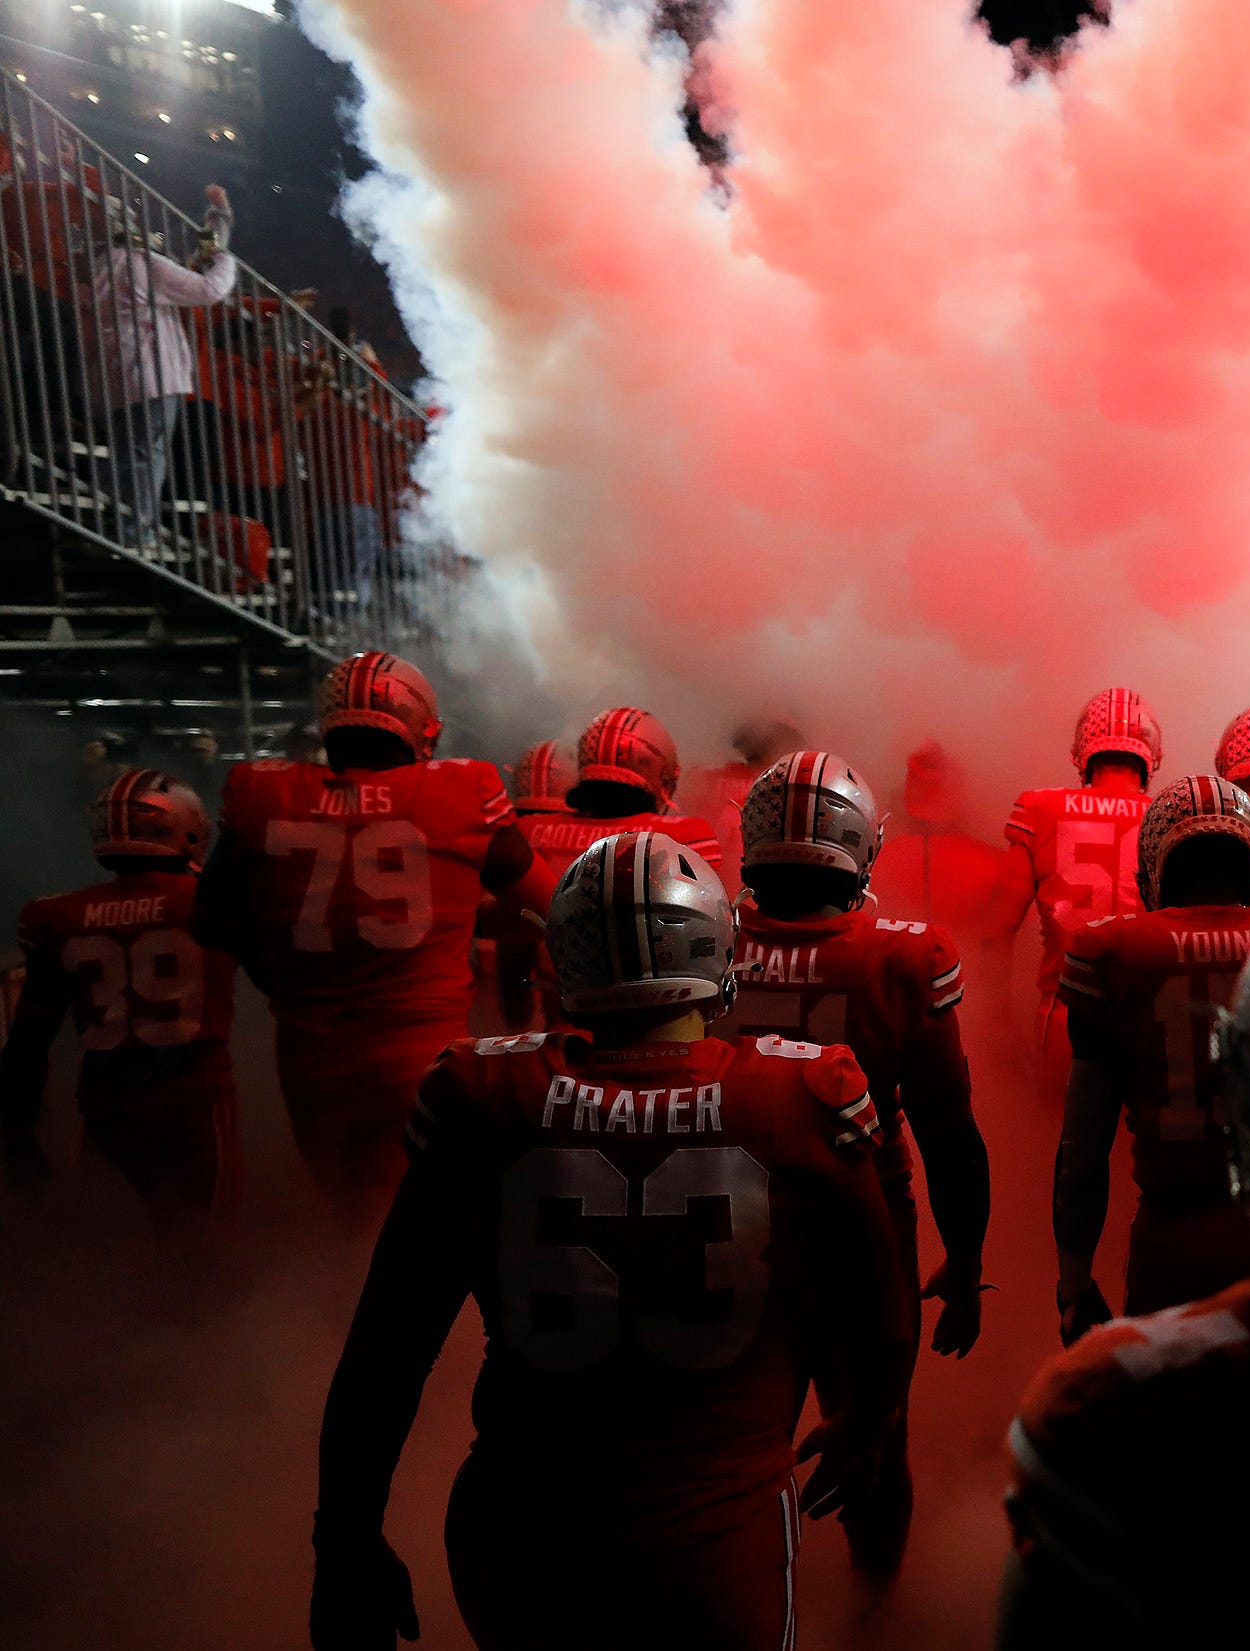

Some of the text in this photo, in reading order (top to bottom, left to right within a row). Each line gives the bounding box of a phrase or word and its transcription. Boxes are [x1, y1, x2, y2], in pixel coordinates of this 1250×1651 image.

[309, 785, 393, 816] JONES
[83, 896, 168, 928] MOORE
[264, 818, 434, 953] 79
[61, 926, 205, 1051] 39
[741, 941, 824, 984] HALL
[1154, 973, 1241, 1142] 1
[541, 1074, 722, 1135] PRATER
[497, 1146, 771, 1371] 63
